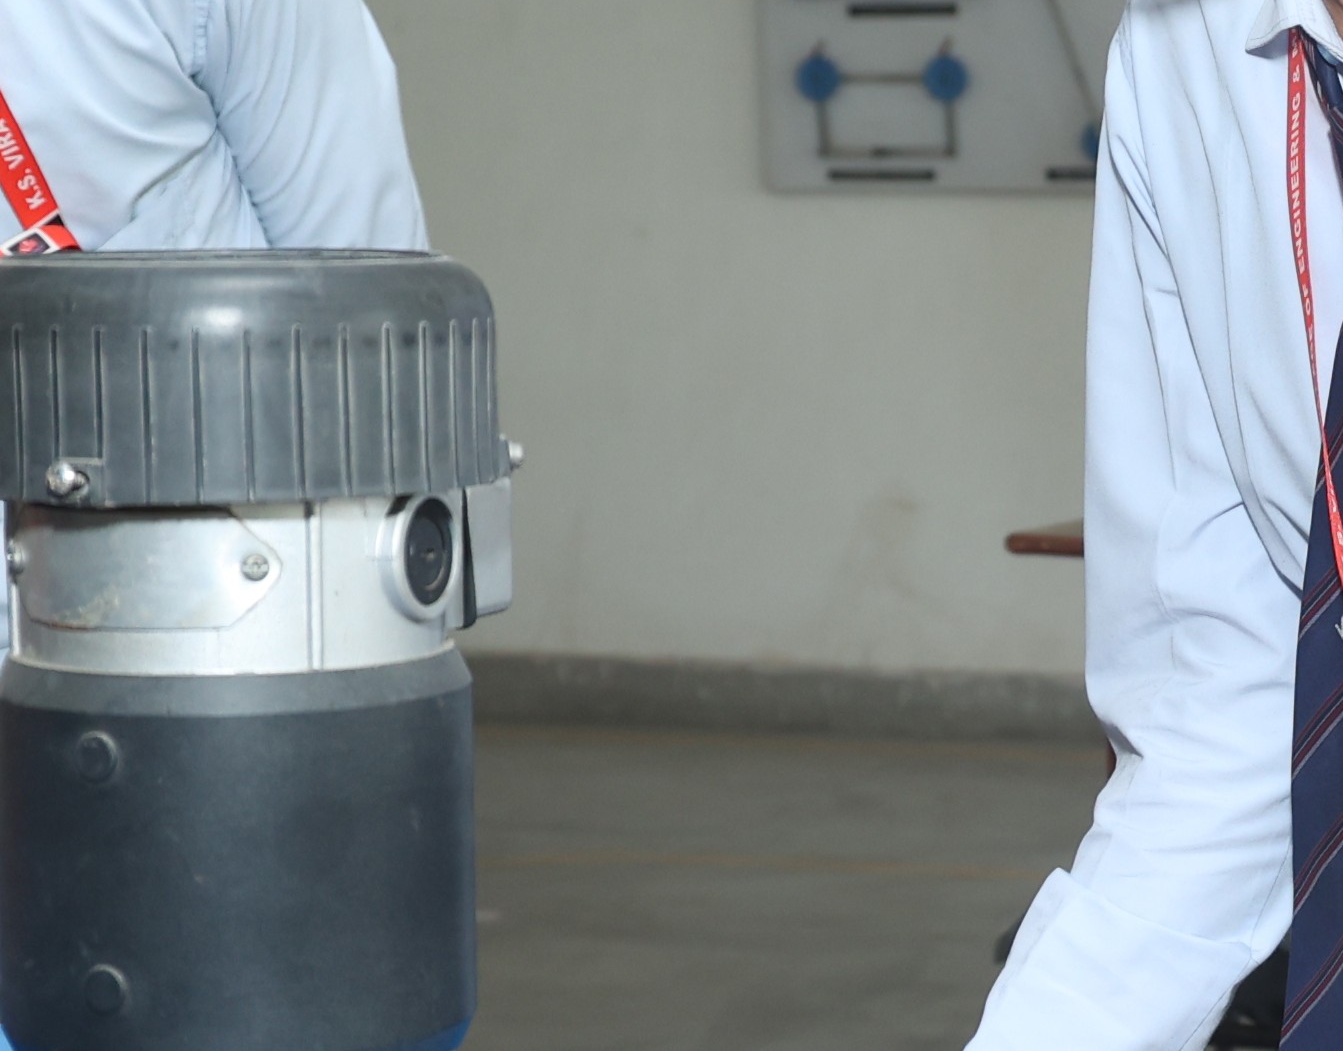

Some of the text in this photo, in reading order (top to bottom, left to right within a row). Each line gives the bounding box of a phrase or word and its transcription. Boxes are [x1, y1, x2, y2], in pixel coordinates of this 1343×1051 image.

[1292, 64, 1300, 83] &
[17, 168, 46, 210] K.S.
[1290, 92, 1304, 275] ENGINEERING
